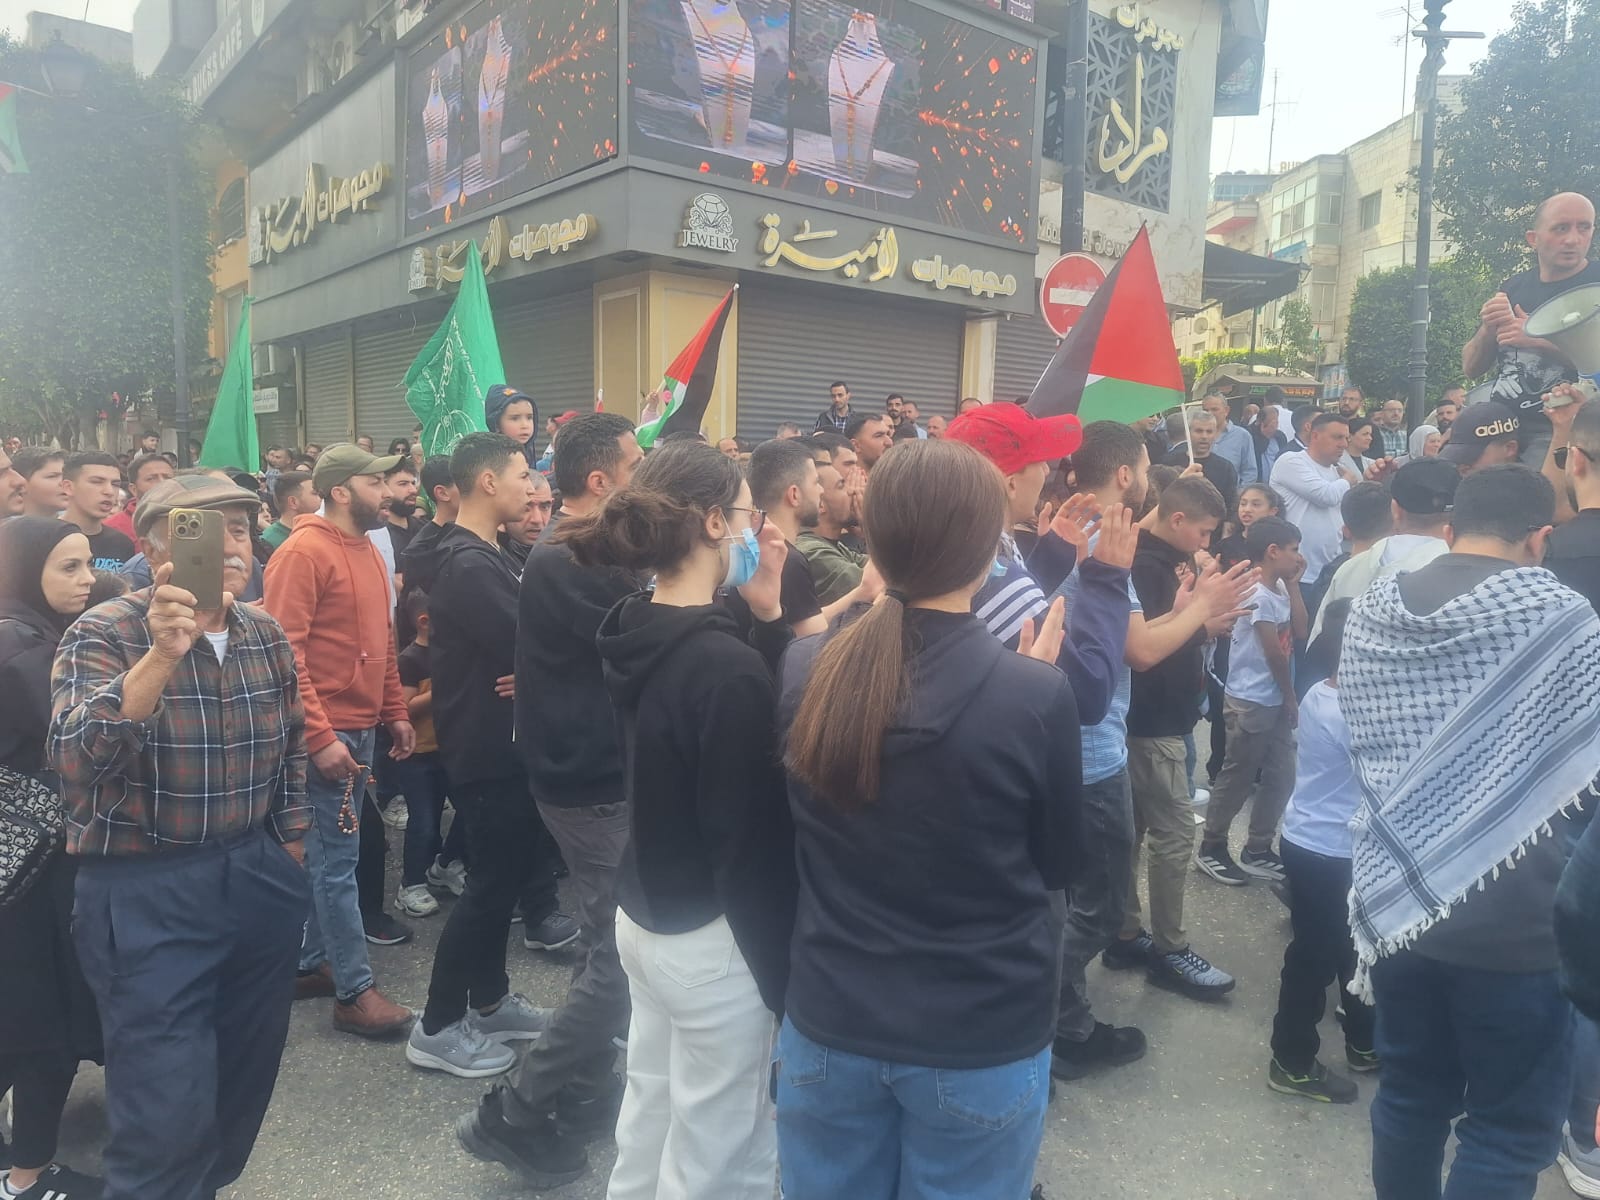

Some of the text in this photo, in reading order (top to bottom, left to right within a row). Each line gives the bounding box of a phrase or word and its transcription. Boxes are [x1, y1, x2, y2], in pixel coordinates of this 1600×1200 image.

[220, 17, 242, 70] CAFE
[509, 213, 590, 262] مجوهرات
[683, 230, 738, 252] JEWELRY
[912, 254, 1017, 298] مجوهرات
